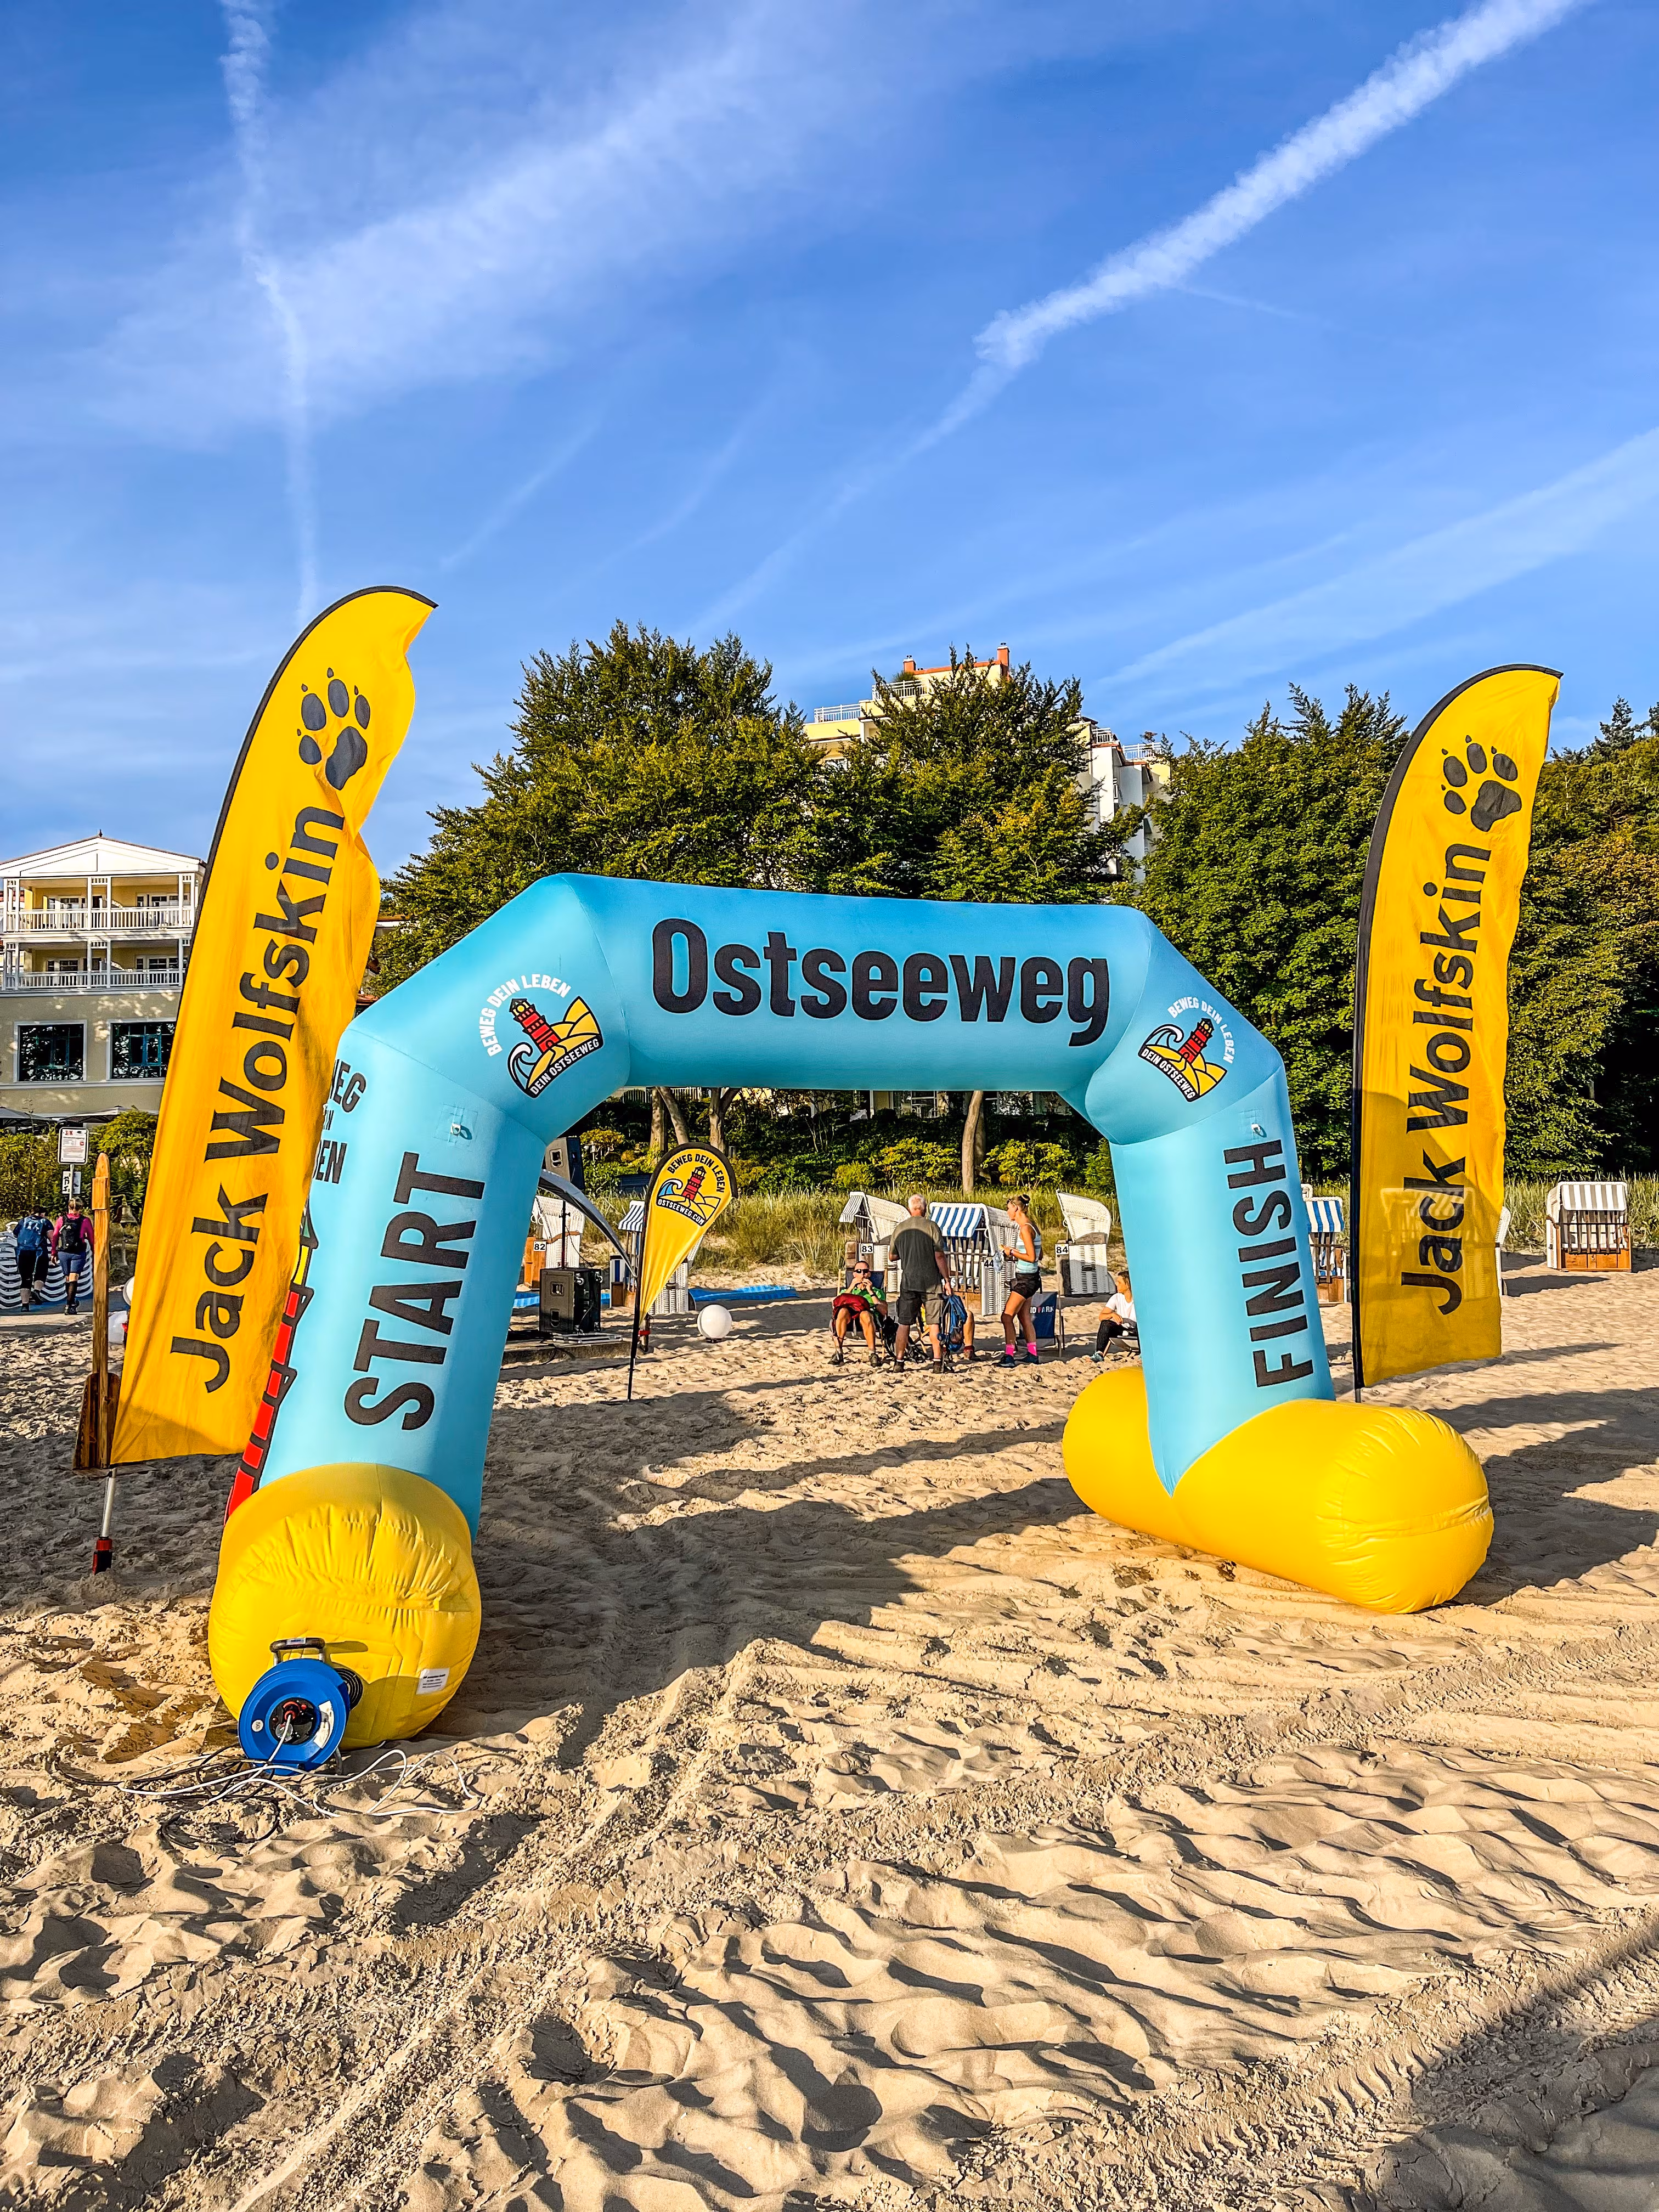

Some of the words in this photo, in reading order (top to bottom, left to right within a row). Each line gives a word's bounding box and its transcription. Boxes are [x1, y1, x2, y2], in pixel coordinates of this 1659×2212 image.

[204, 806, 345, 1163] Wolfskin
[486, 978, 521, 1008] DEIN
[521, 974, 572, 998] LEBEN
[652, 918, 1109, 1047] Ostseeweg
[1406, 843, 1491, 1133] Wolfskin
[479, 1007, 503, 1057] BEWEG
[1167, 996, 1199, 1018] BEWEG
[1201, 1000, 1223, 1024] DEIN
[1220, 1023, 1235, 1064] LEBEN
[530, 1073, 551, 1095] DEIN
[549, 1038, 600, 1076] OSTSEEWEG
[1141, 1048, 1162, 1065] DEIN
[1159, 1060, 1196, 1099] OSTSEEWEG
[667, 1153, 693, 1174] BEWEG
[695, 1153, 715, 1168] DEIN
[712, 1165, 725, 1193] LEBEN
[658, 1199, 705, 1225] OSTSEEWEG.COM
[1401, 1149, 1466, 1315] Jack
[170, 1182, 268, 1393] Jack
[344, 1151, 485, 1431] START
[984, 1259, 994, 1268] 44
[1223, 1139, 1313, 1387] FINISH
